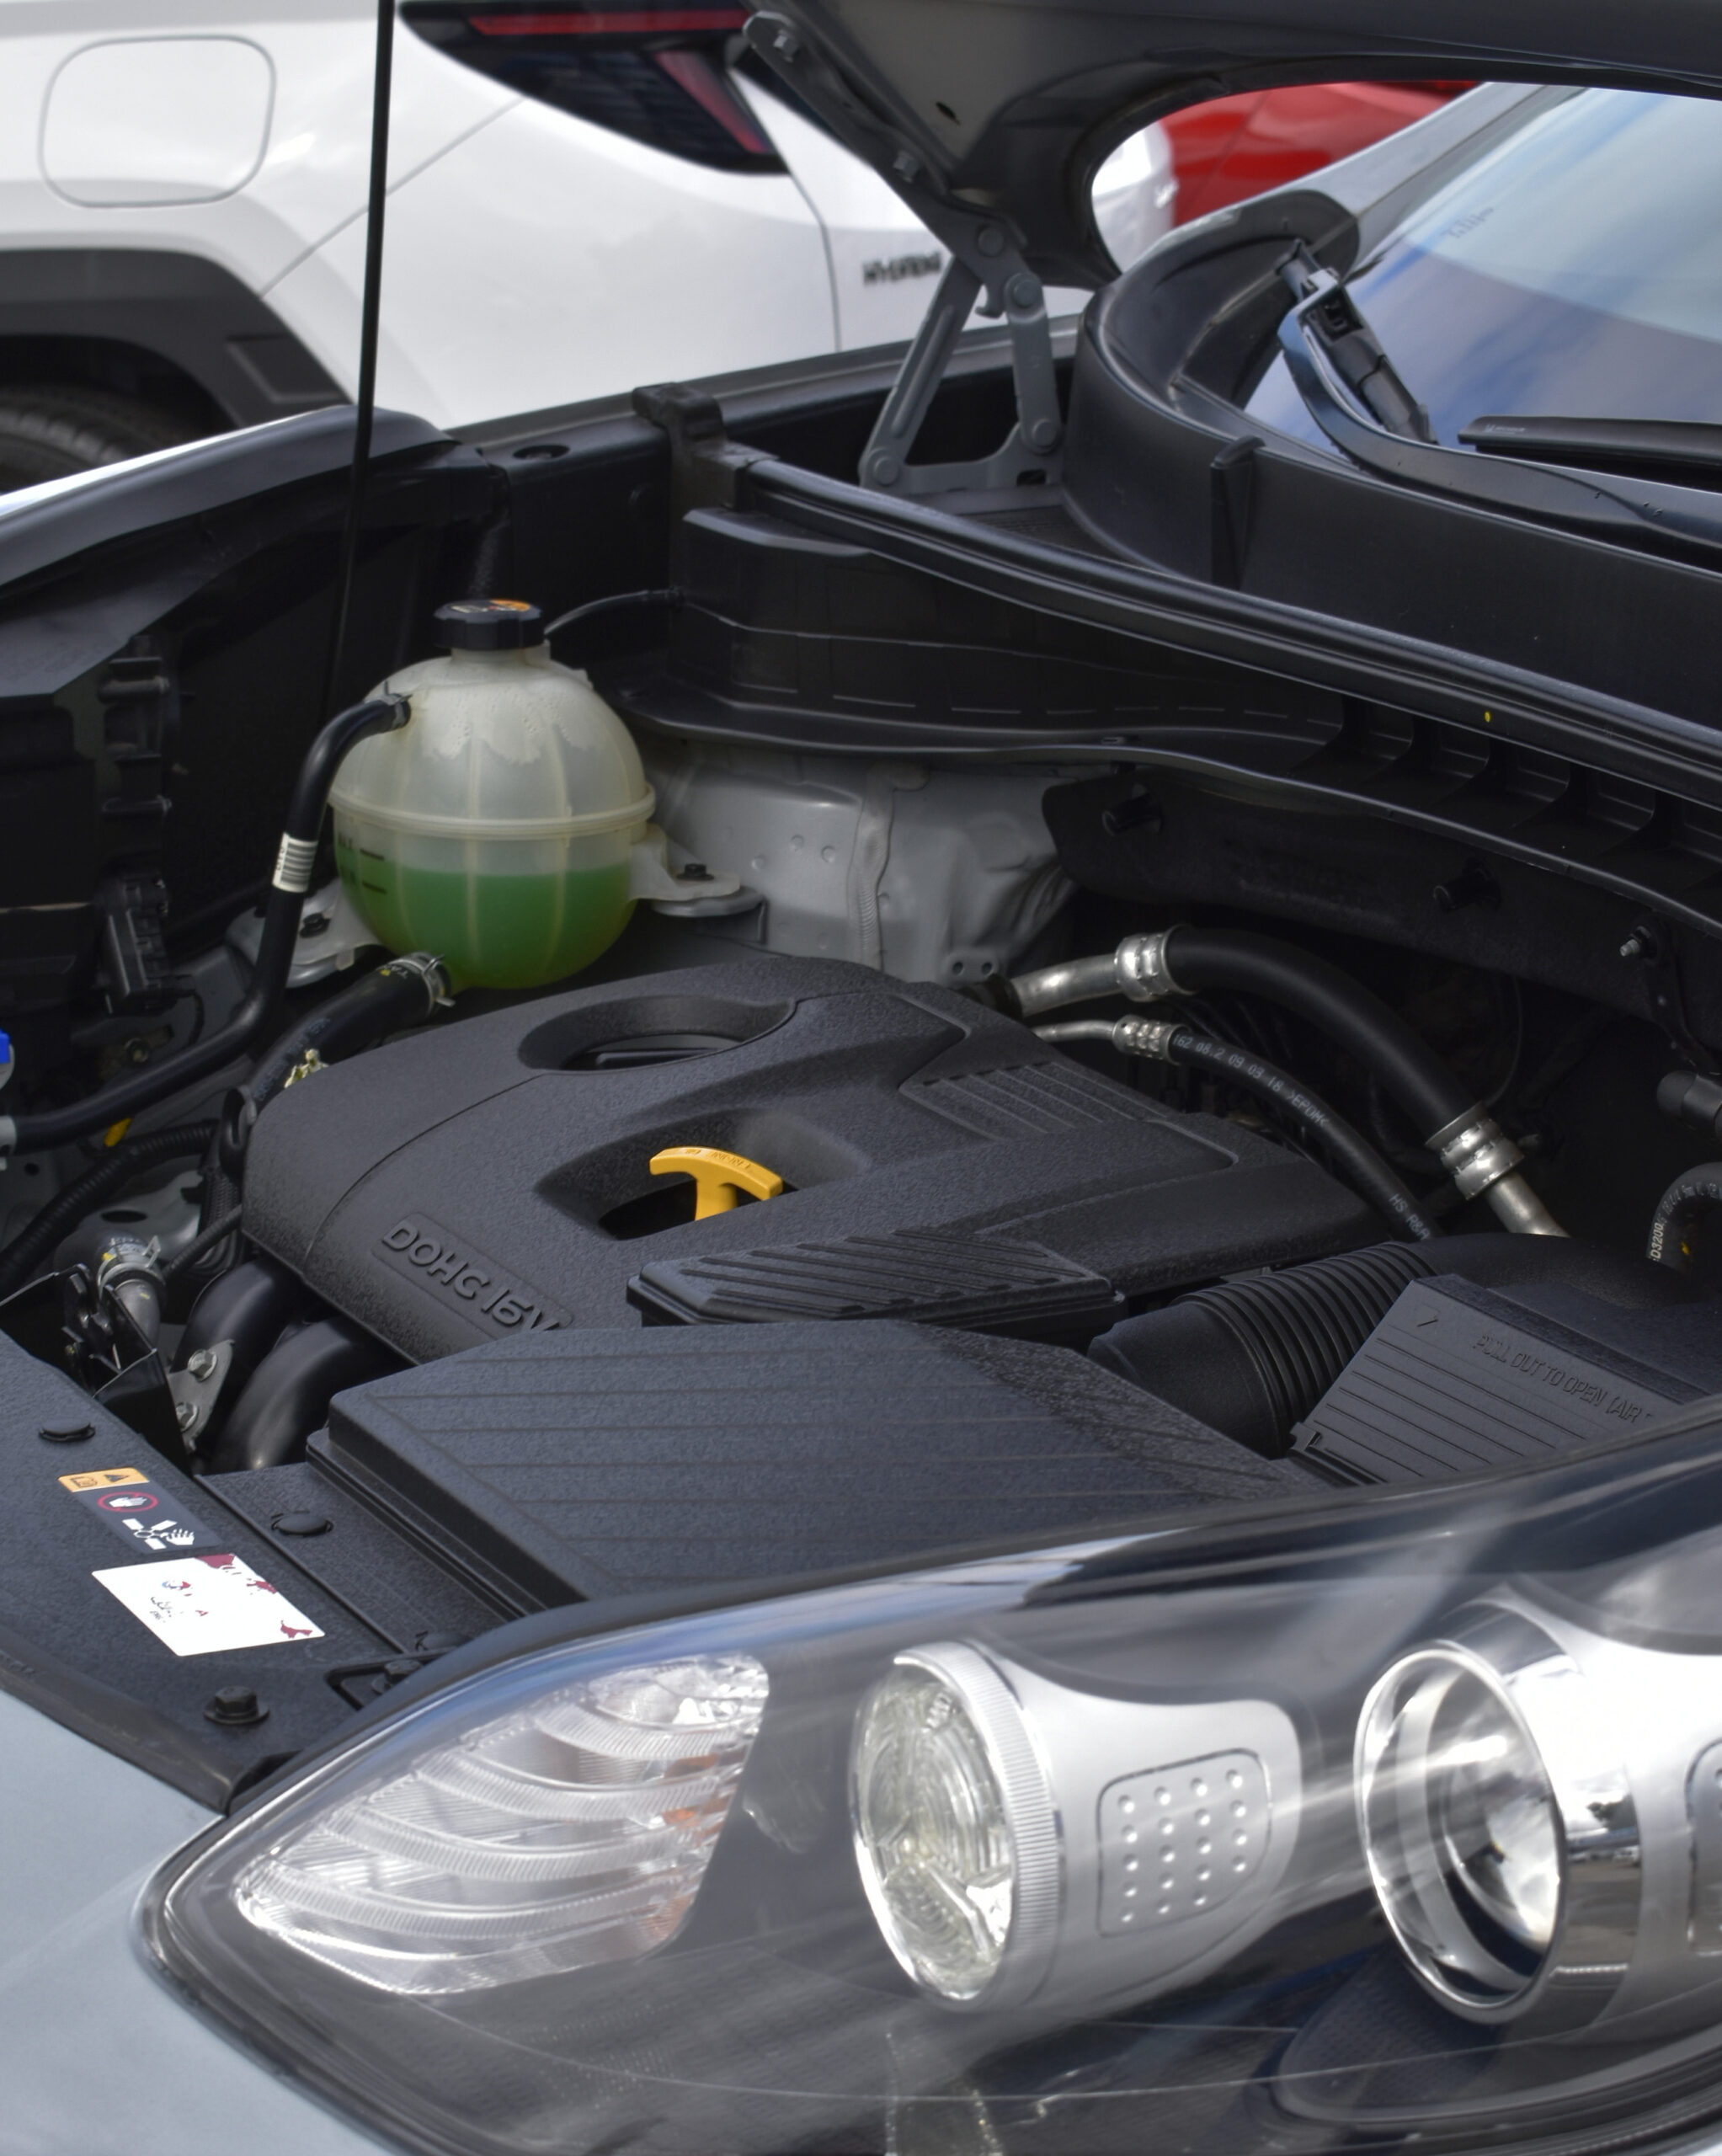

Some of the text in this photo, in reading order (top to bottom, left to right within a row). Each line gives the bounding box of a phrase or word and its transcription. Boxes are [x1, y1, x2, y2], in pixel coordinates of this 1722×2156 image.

[1229, 1053, 1245, 1069] 09
[1267, 1075, 1285, 1092] 18
[1389, 1193, 1408, 1213] HS
[381, 1220, 491, 1300] DOHC
[1511, 1352, 1547, 1376] OUT
[1542, 1365, 1567, 1386] TO
[1563, 1376, 1607, 1407] OPEN
